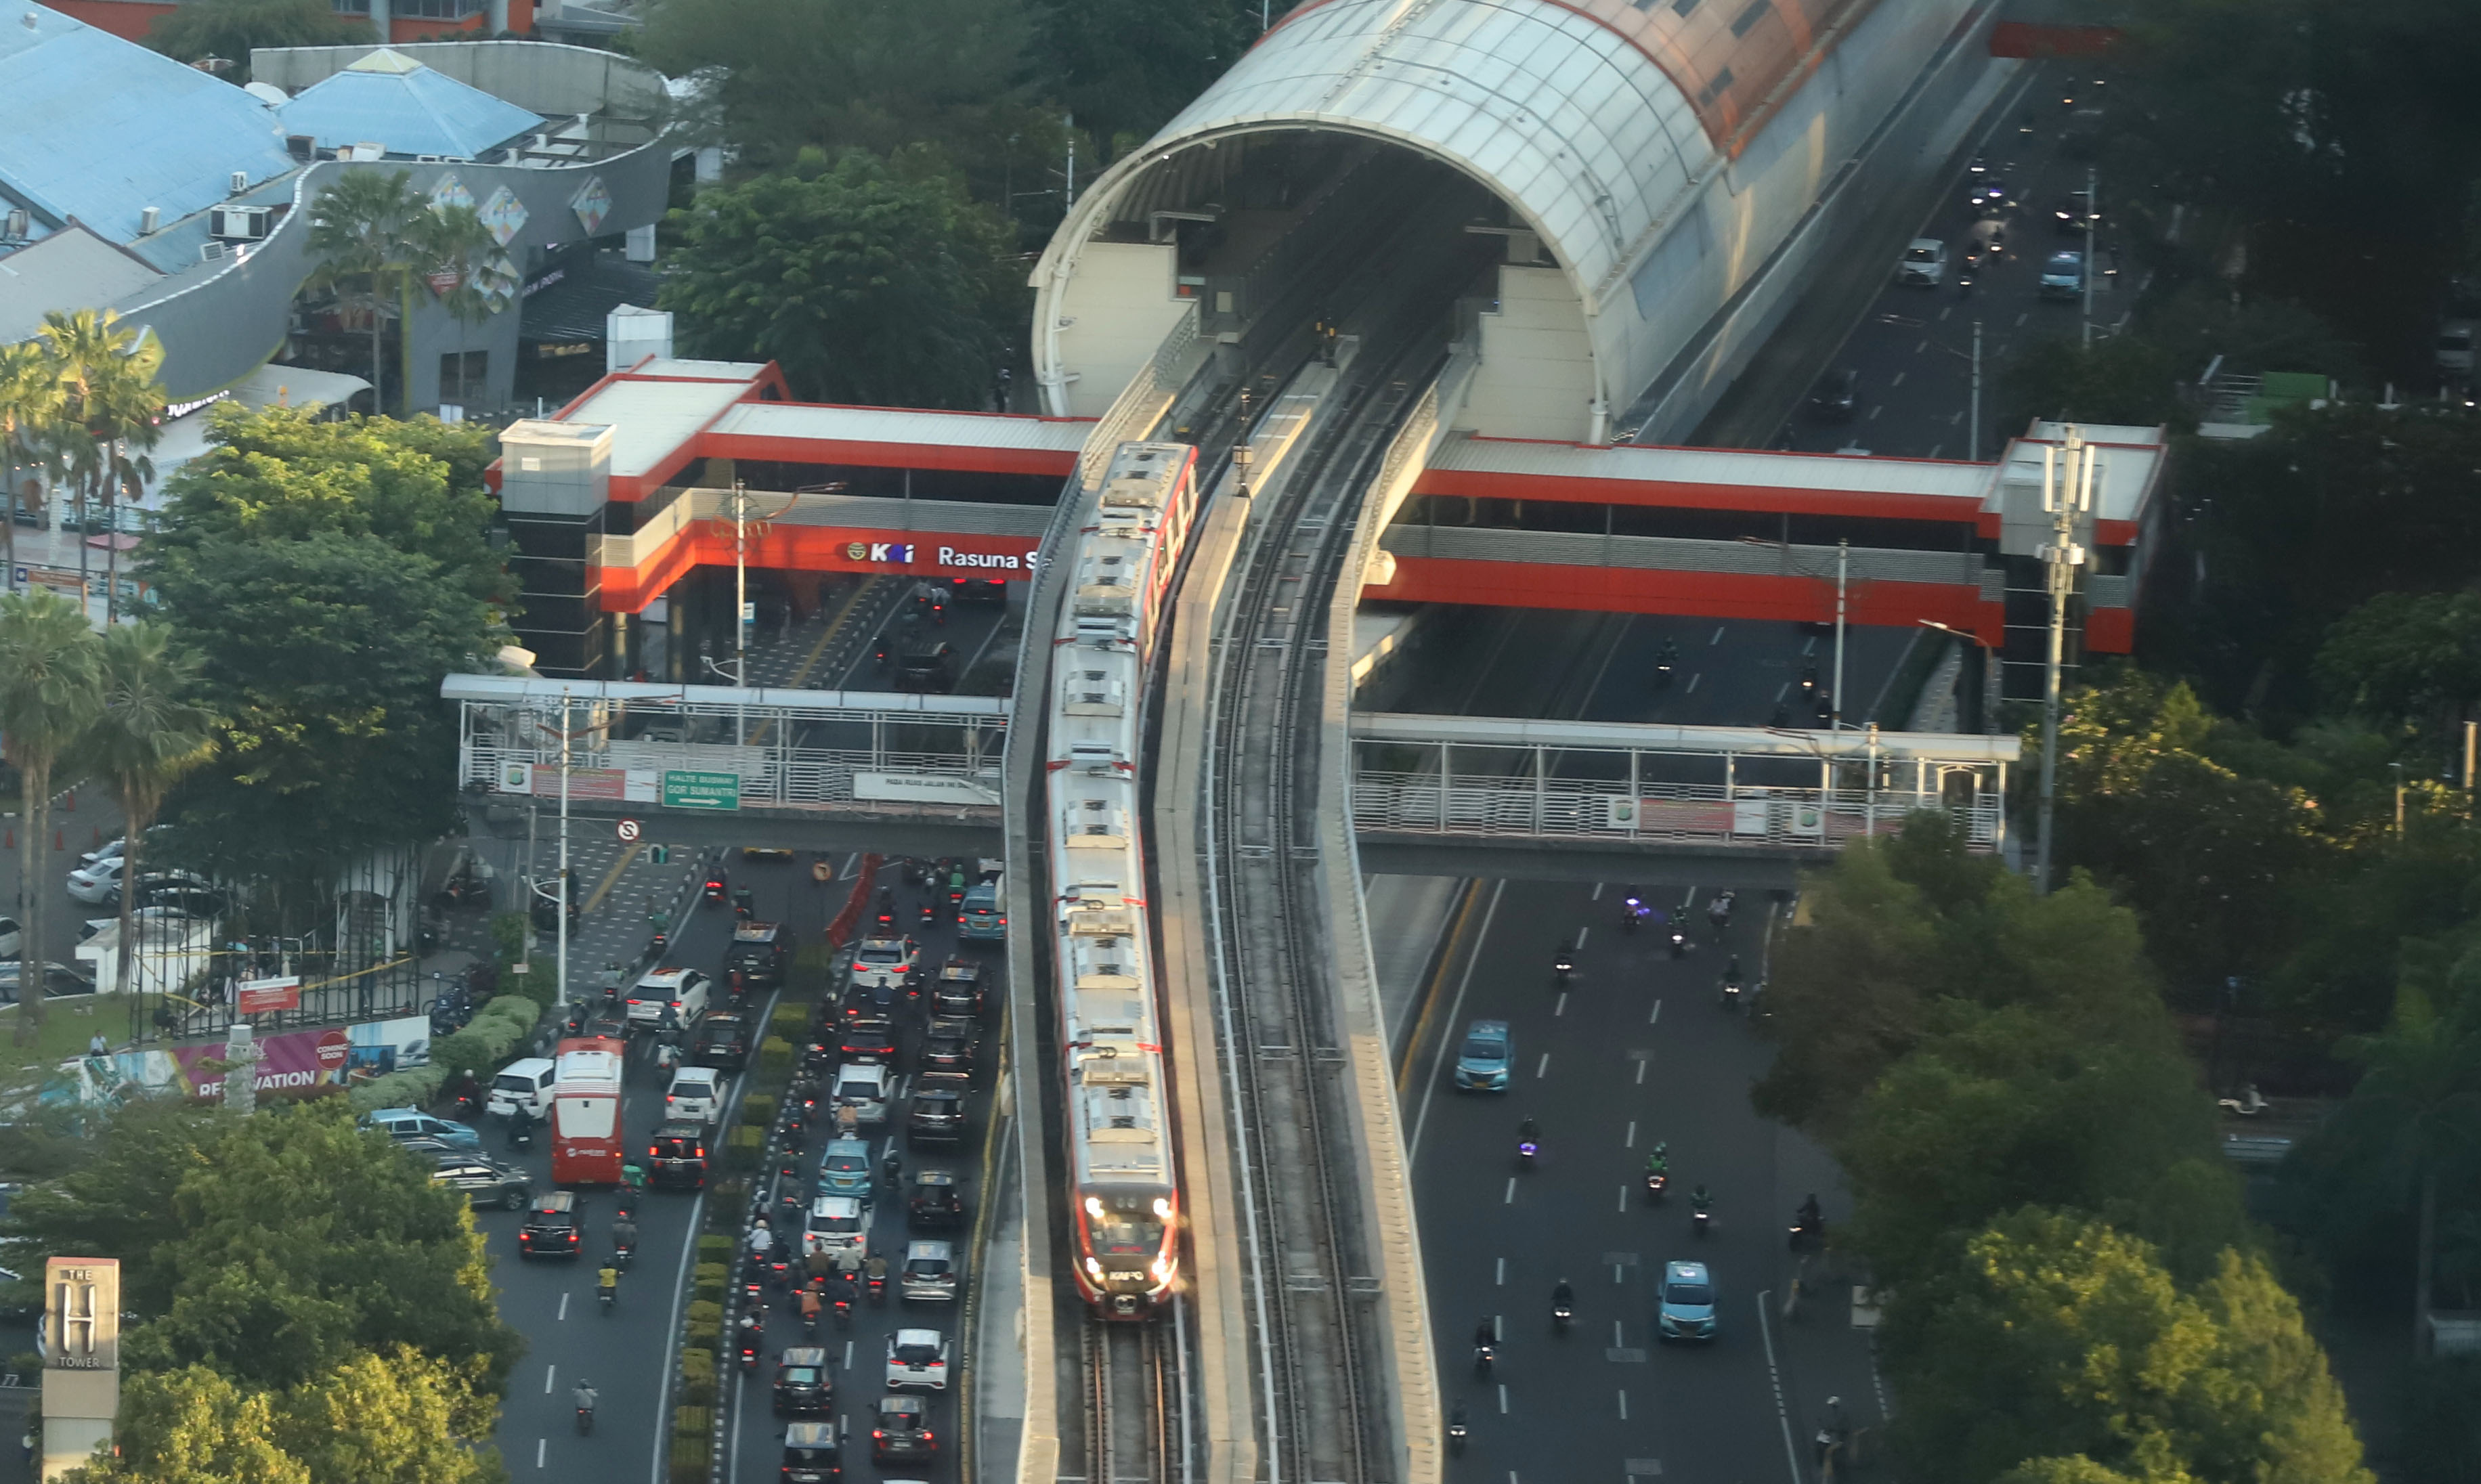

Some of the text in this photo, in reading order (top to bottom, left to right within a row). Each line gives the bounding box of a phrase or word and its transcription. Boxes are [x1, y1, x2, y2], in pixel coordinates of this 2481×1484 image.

[939, 546, 1019, 569] Rasuna
[668, 774, 735, 784] HALTE BUSWAY
[668, 785, 687, 794] GOR
[690, 785, 736, 797] SUMANTRI
[317, 1043, 347, 1053] COMING
[320, 1051, 343, 1060] SOON
[68, 1270, 93, 1281] THE
[63, 1284, 96, 1353] H
[60, 1357, 100, 1368] TOWER
